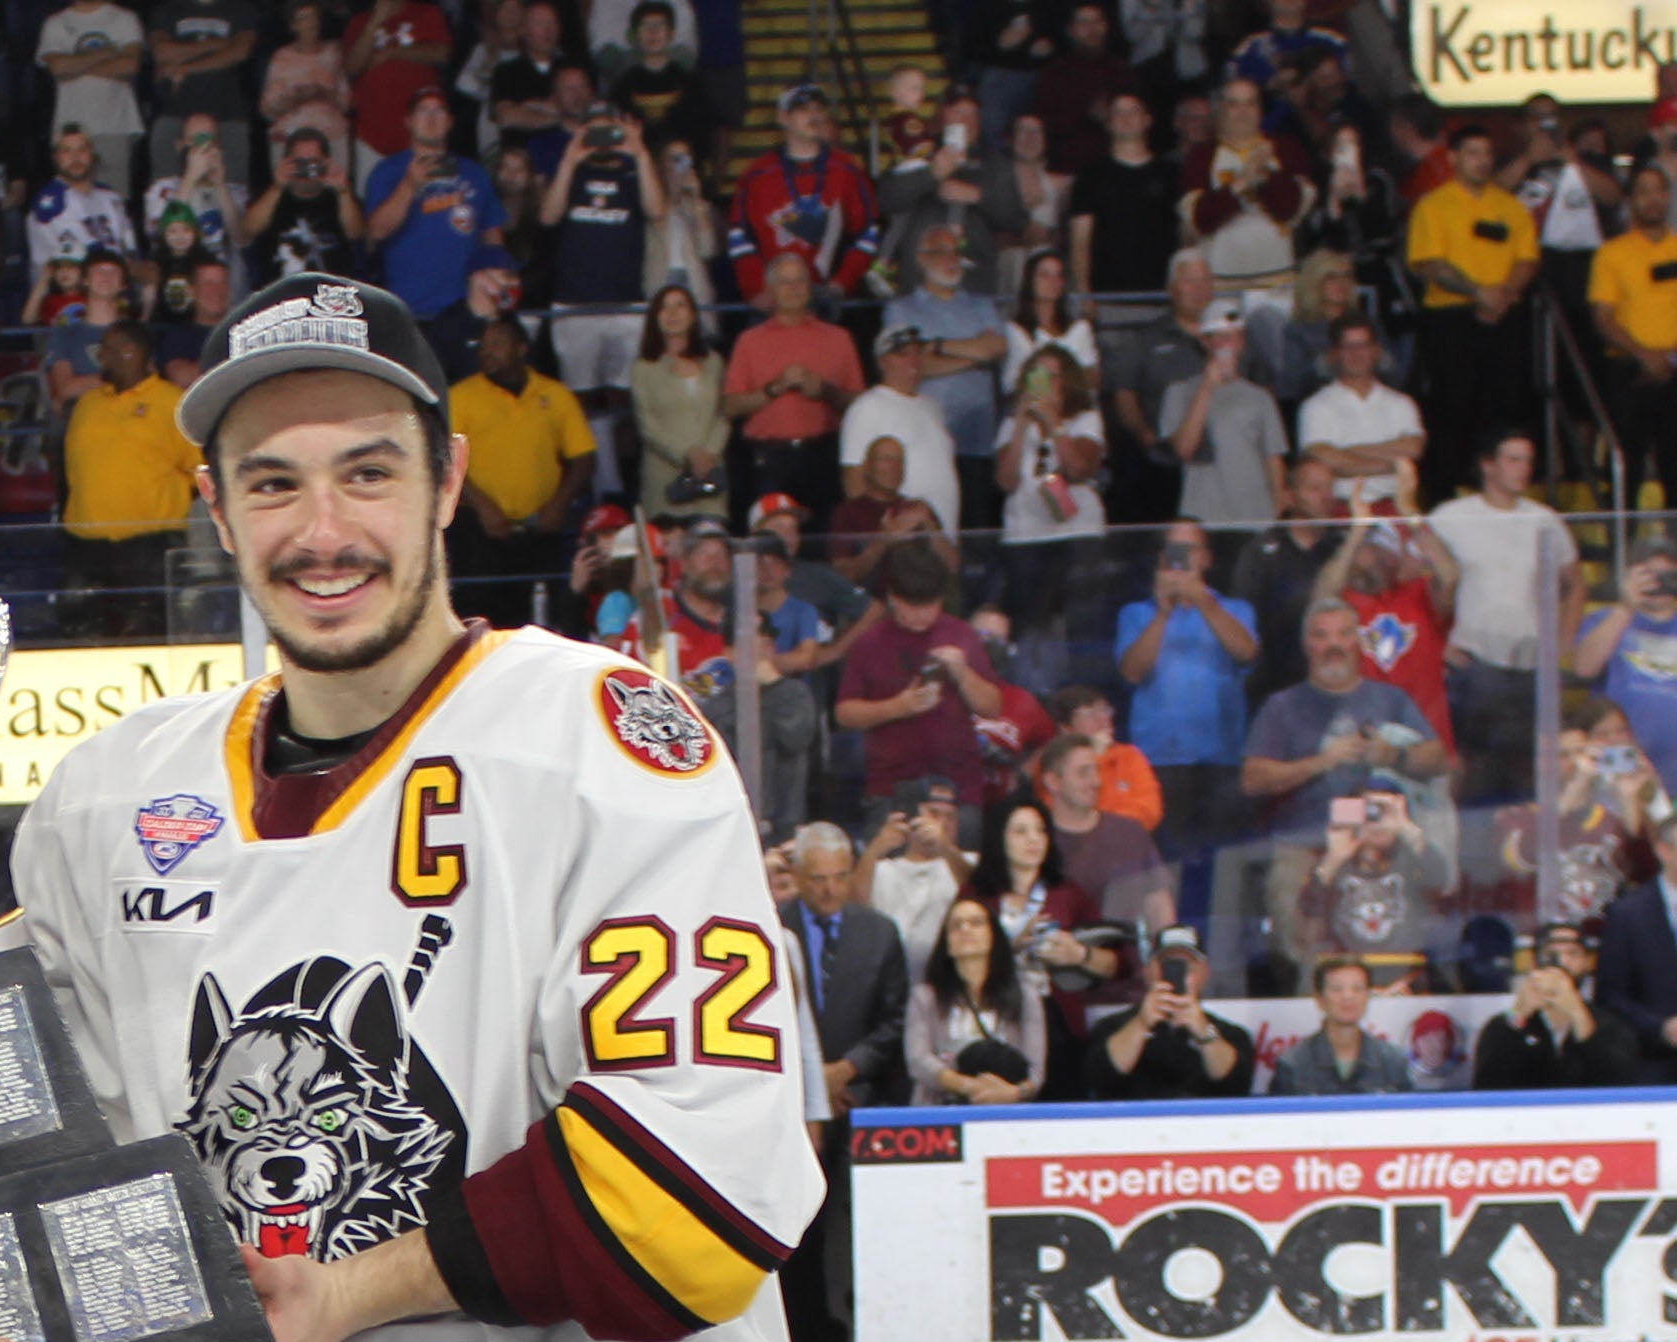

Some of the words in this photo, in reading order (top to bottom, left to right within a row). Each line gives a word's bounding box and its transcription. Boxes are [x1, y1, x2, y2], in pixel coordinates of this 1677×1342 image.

[390, 755, 470, 909] C
[580, 913, 784, 1075] 22
[1041, 1160, 1282, 1204] Experience
[1293, 1155, 1363, 1192] the
[1375, 1150, 1603, 1191] difference
[987, 1196, 1677, 1340] ROCKY'
